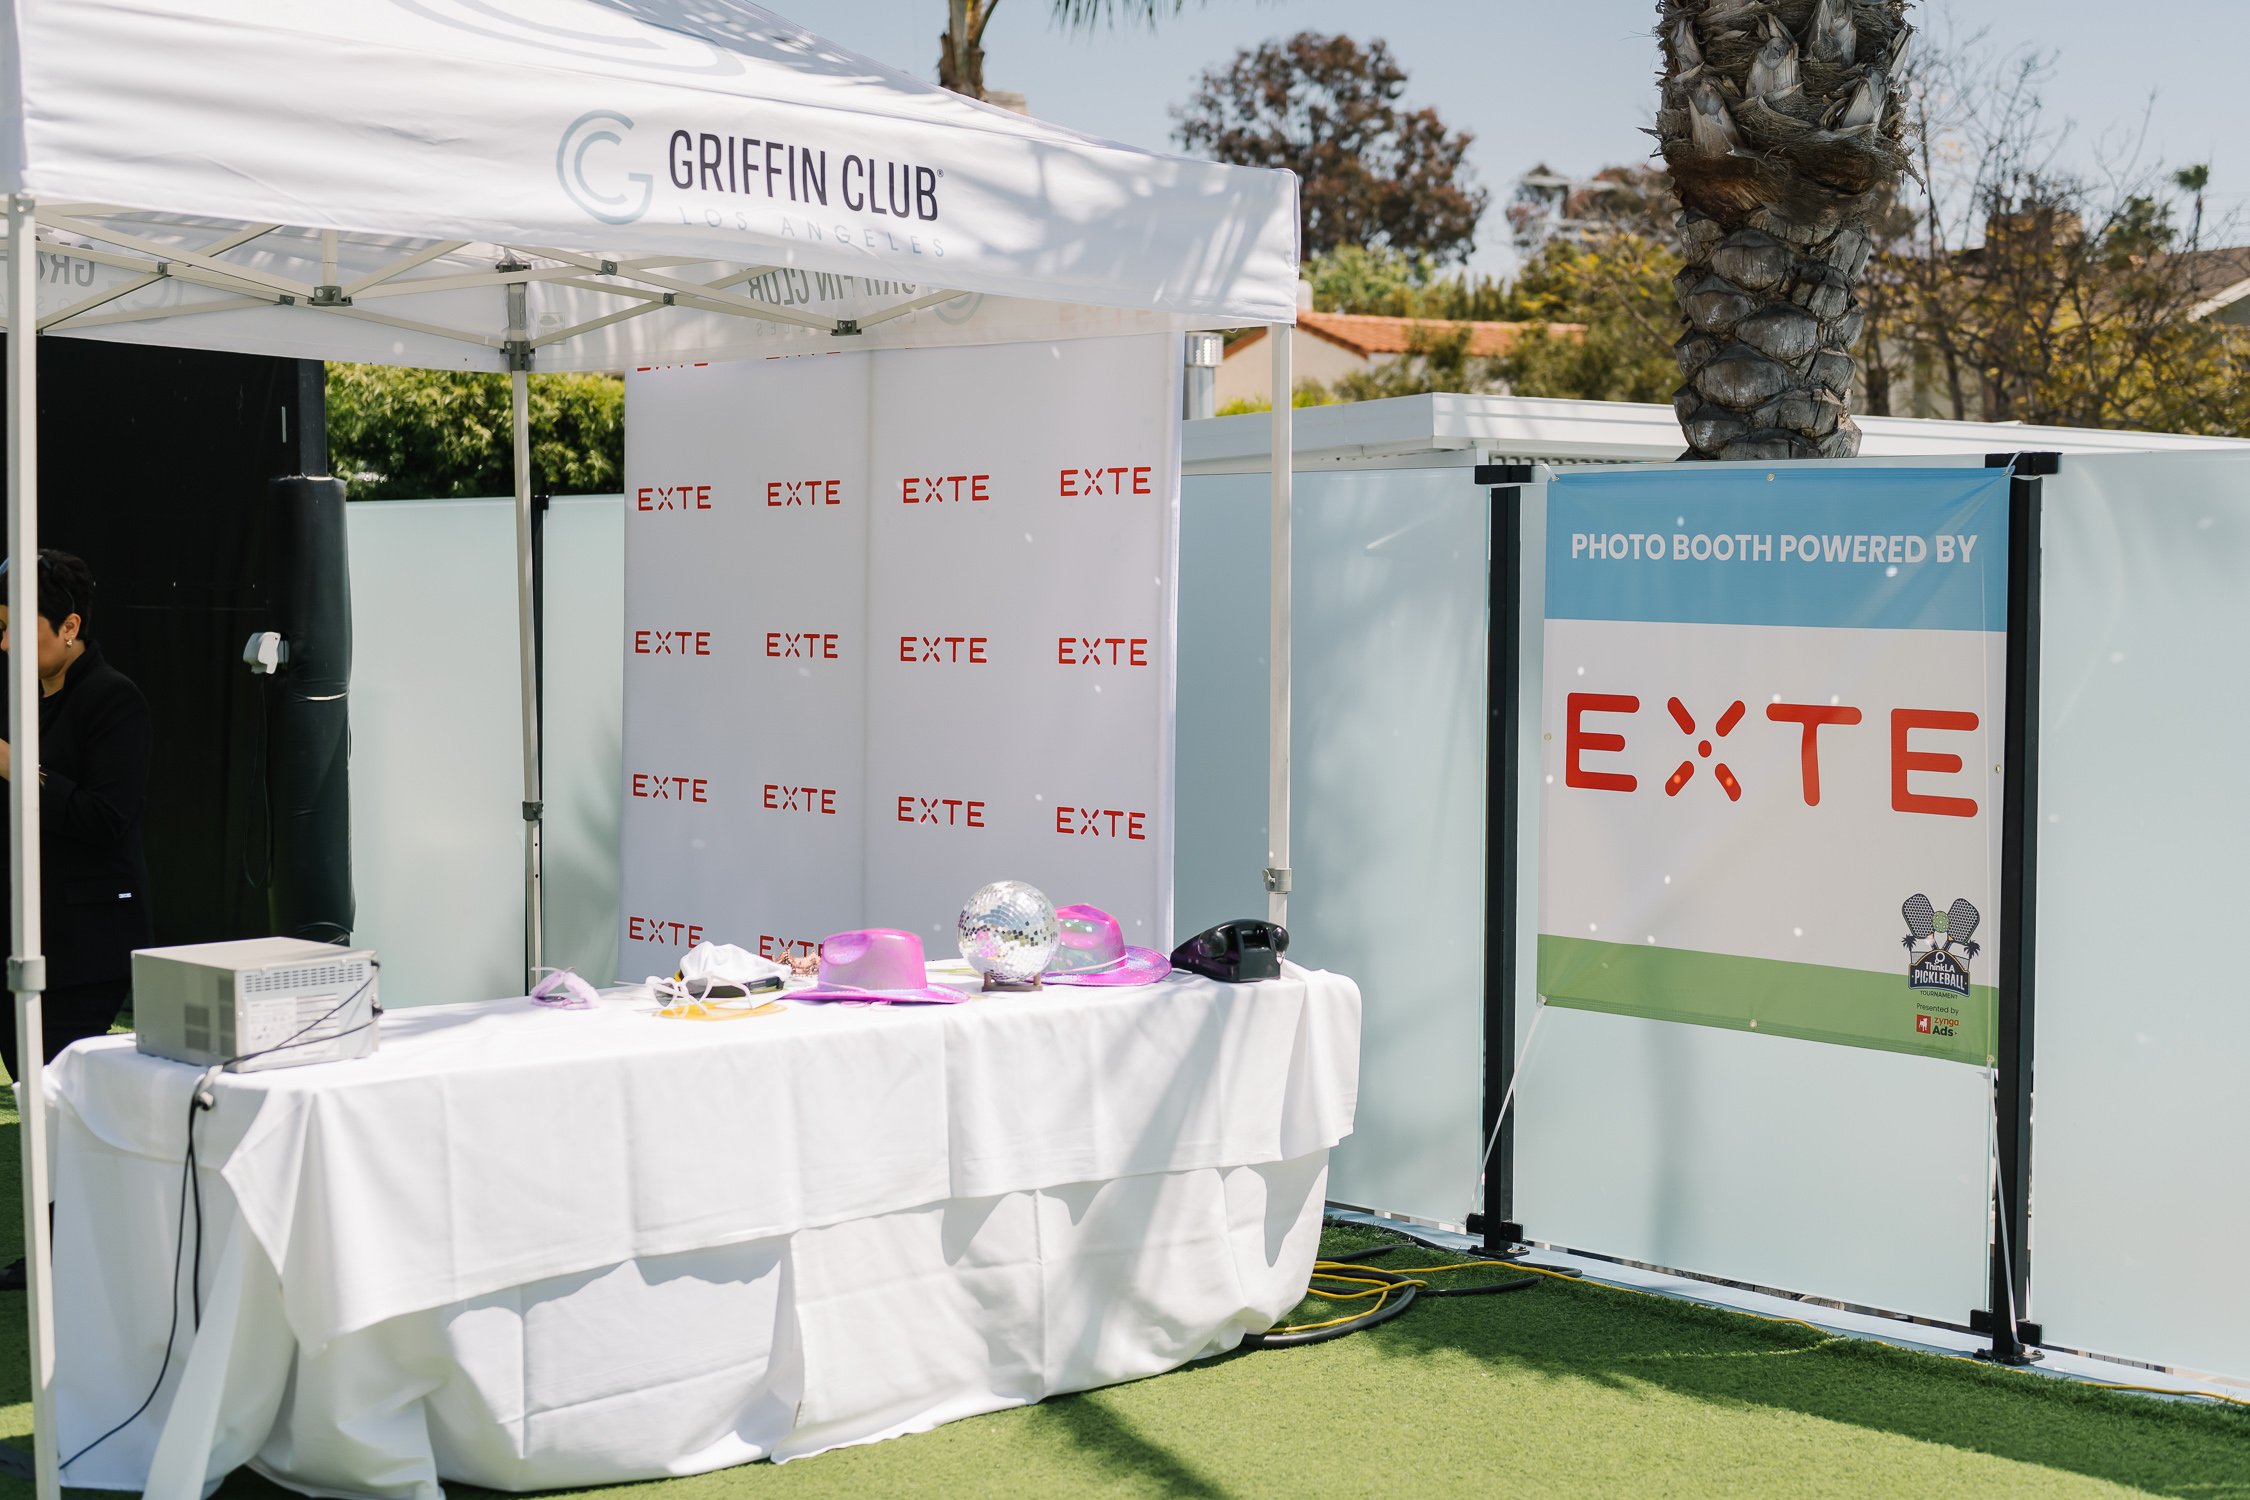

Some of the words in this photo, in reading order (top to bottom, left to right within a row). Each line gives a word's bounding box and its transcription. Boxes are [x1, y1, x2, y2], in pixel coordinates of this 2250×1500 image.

[669, 129, 828, 206] GRIFFIN
[679, 206, 748, 231] LOS
[781, 216, 944, 257] ANGELES
[768, 480, 840, 506] EXTE
[903, 475, 990, 504] EXTE
[1060, 466, 1151, 496] EXTE
[638, 486, 711, 511] EXTE
[1571, 533, 1666, 560] PHOTO
[1673, 534, 1772, 561] BOOTH
[1780, 534, 1927, 563] POWERED
[1936, 535, 1978, 563] BY
[635, 631, 711, 656] EXTE
[767, 633, 838, 658] EXTE
[900, 636, 987, 664] EXTE
[1058, 637, 1148, 666] EXTE
[1566, 692, 1979, 818] EXTE
[633, 774, 708, 803] EXTE
[764, 785, 836, 814] EXTE
[898, 796, 985, 827] EXTE
[1056, 806, 1146, 840] EXTE
[629, 916, 703, 948] EXTE
[1914, 969, 1965, 991] PICKLEBALL
[1924, 961, 1955, 973] ThinkLA
[1917, 1003, 1949, 1014] Presented
[1950, 1007, 1959, 1015] by
[1920, 991, 1958, 999] TOURNAMENT
[1932, 1025, 1954, 1037] Ads
[1934, 1017, 1959, 1027] zynga
